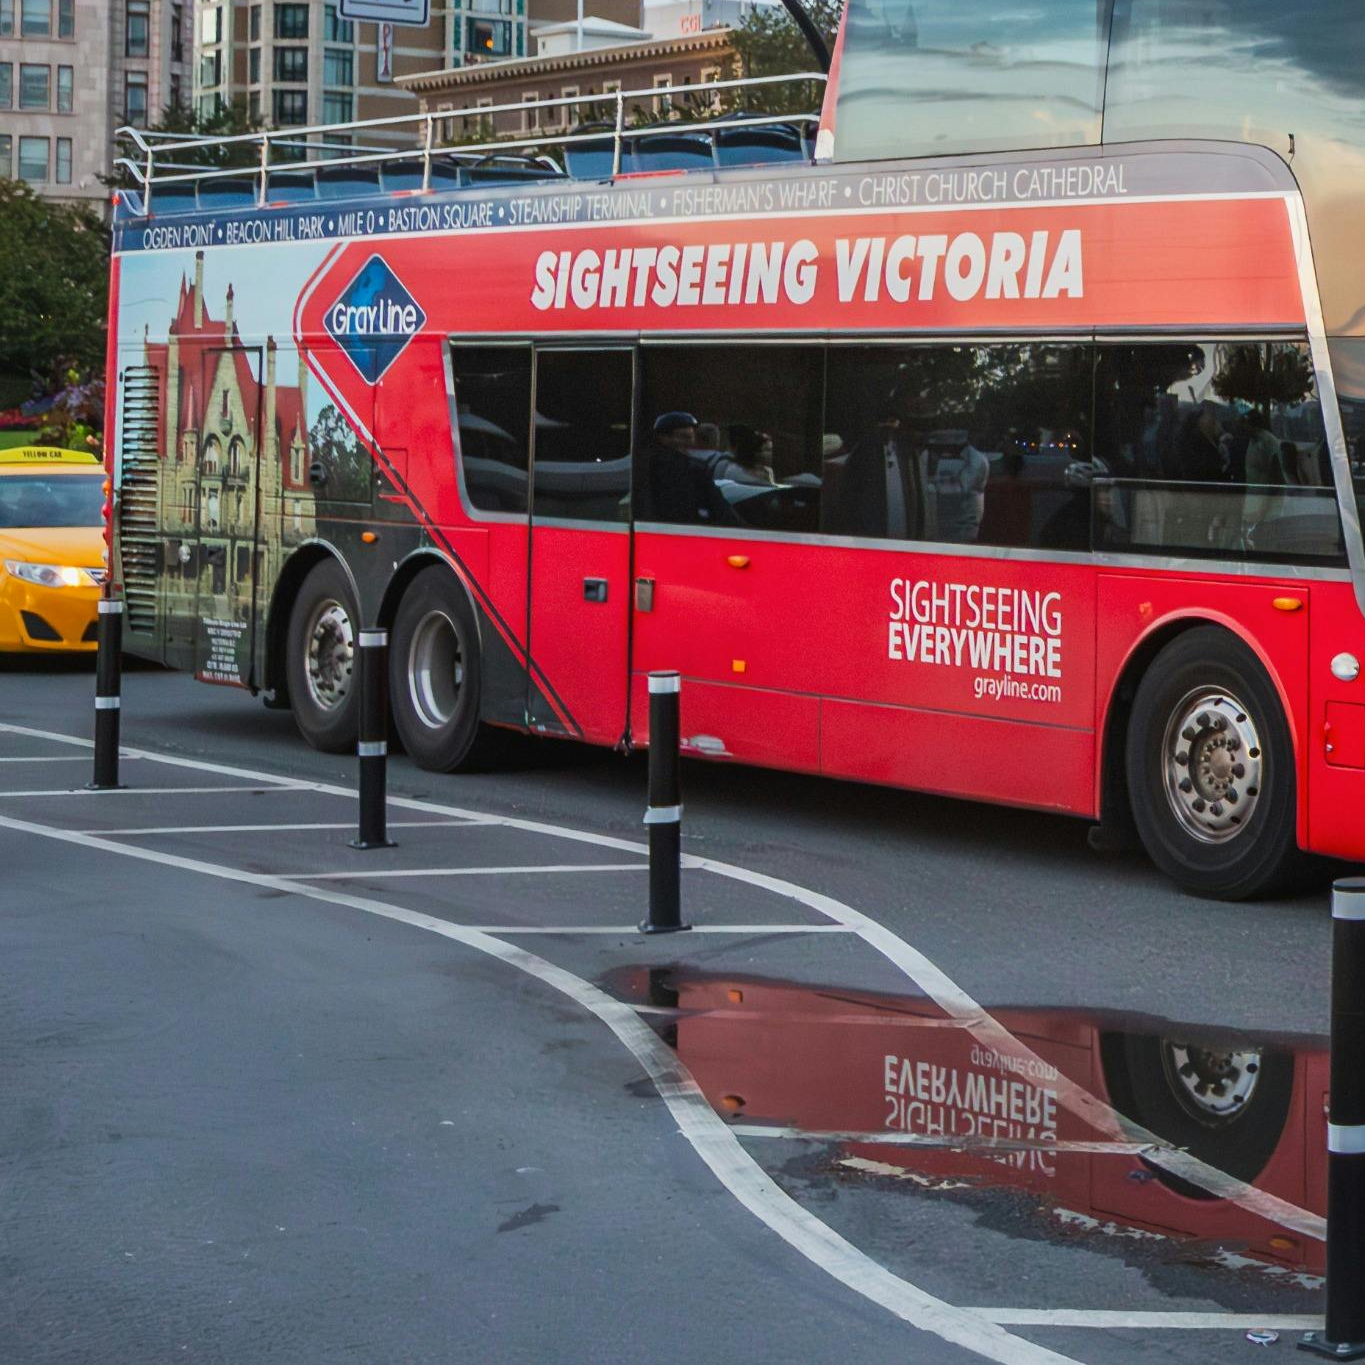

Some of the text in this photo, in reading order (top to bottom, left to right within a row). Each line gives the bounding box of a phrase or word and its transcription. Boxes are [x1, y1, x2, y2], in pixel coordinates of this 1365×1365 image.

[143, 227, 182, 250] OGDEN
[183, 223, 215, 247] POINT
[226, 220, 273, 244] BEACON
[274, 218, 296, 240] HILL
[298, 215, 325, 237] PARK
[338, 212, 363, 234] MILE
[388, 206, 439, 232] BASTION
[444, 202, 494, 229] SQUARE
[509, 195, 582, 225] STEAMSHIP
[586, 191, 654, 219] TERMINAL
[672, 185, 774, 216] FISHERMAN'S
[779, 179, 839, 209] WHARF
[859, 175, 921, 205] CHRIST
[925, 171, 1007, 202] CHURCH
[1013, 164, 1127, 199] CATHEDRAL
[530, 229, 1083, 310] SIGHTSEEING VICTORIA
[889, 578, 1062, 636] SIGHTSEEING
[888, 621, 1062, 678] EVERYWHERE
[974, 675, 1062, 702] grayline.com
